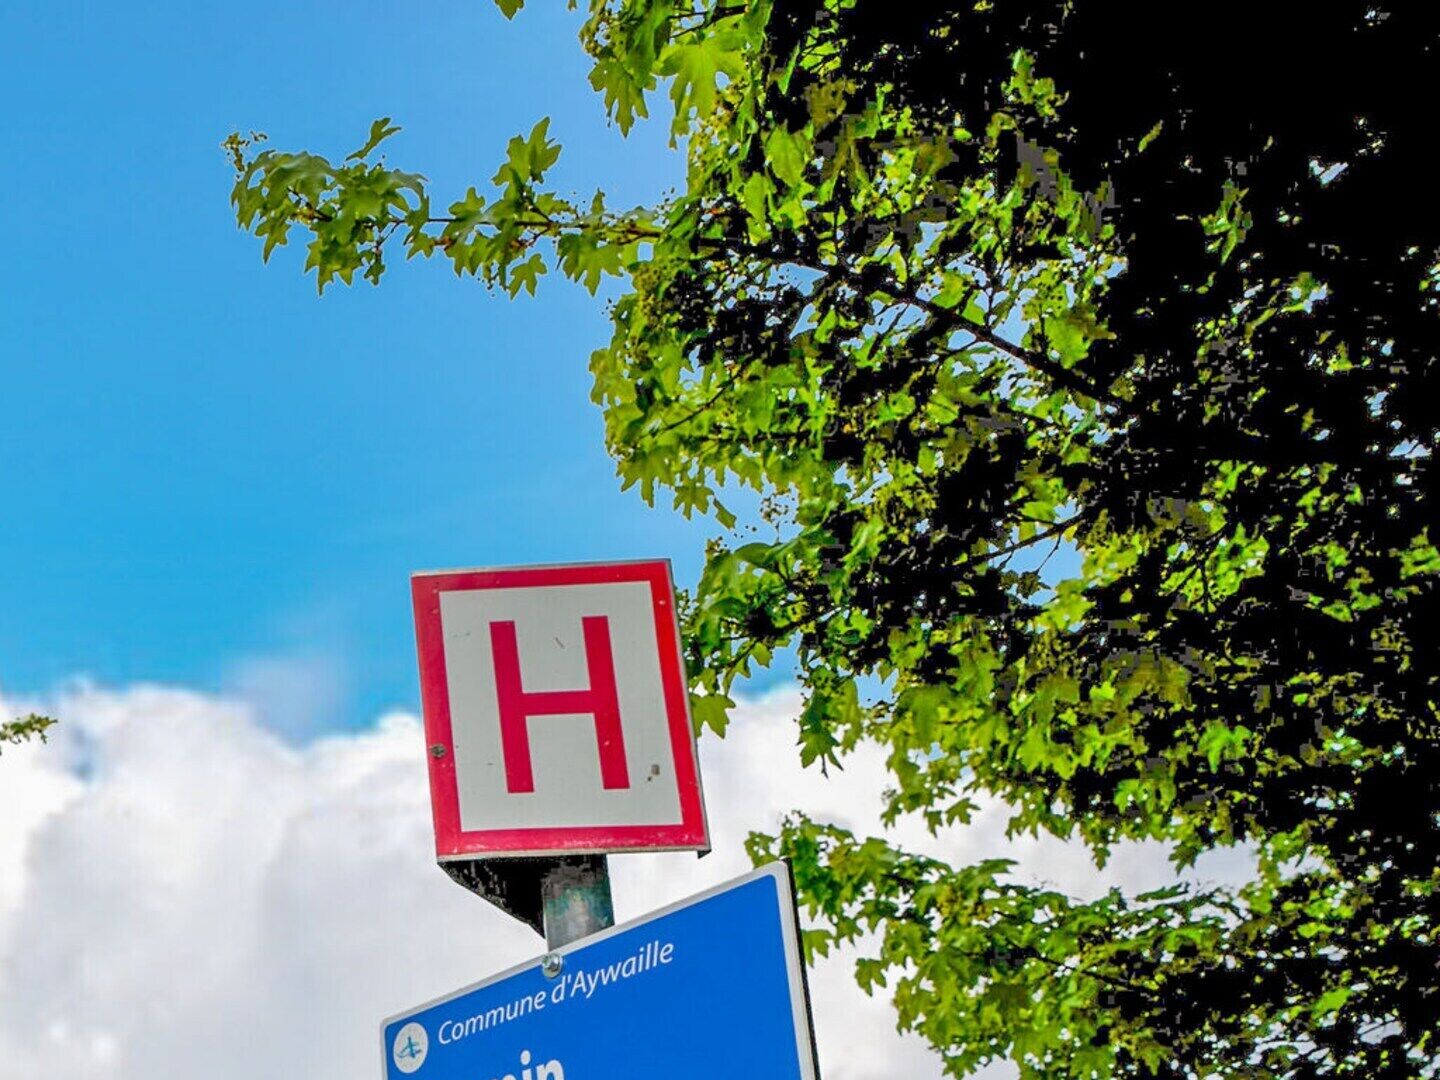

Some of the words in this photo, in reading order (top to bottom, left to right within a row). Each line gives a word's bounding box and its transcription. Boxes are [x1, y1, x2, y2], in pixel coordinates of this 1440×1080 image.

[488, 615, 630, 793] H
[438, 990, 547, 1046] Commune
[550, 941, 676, 1005] d'Aywaille
